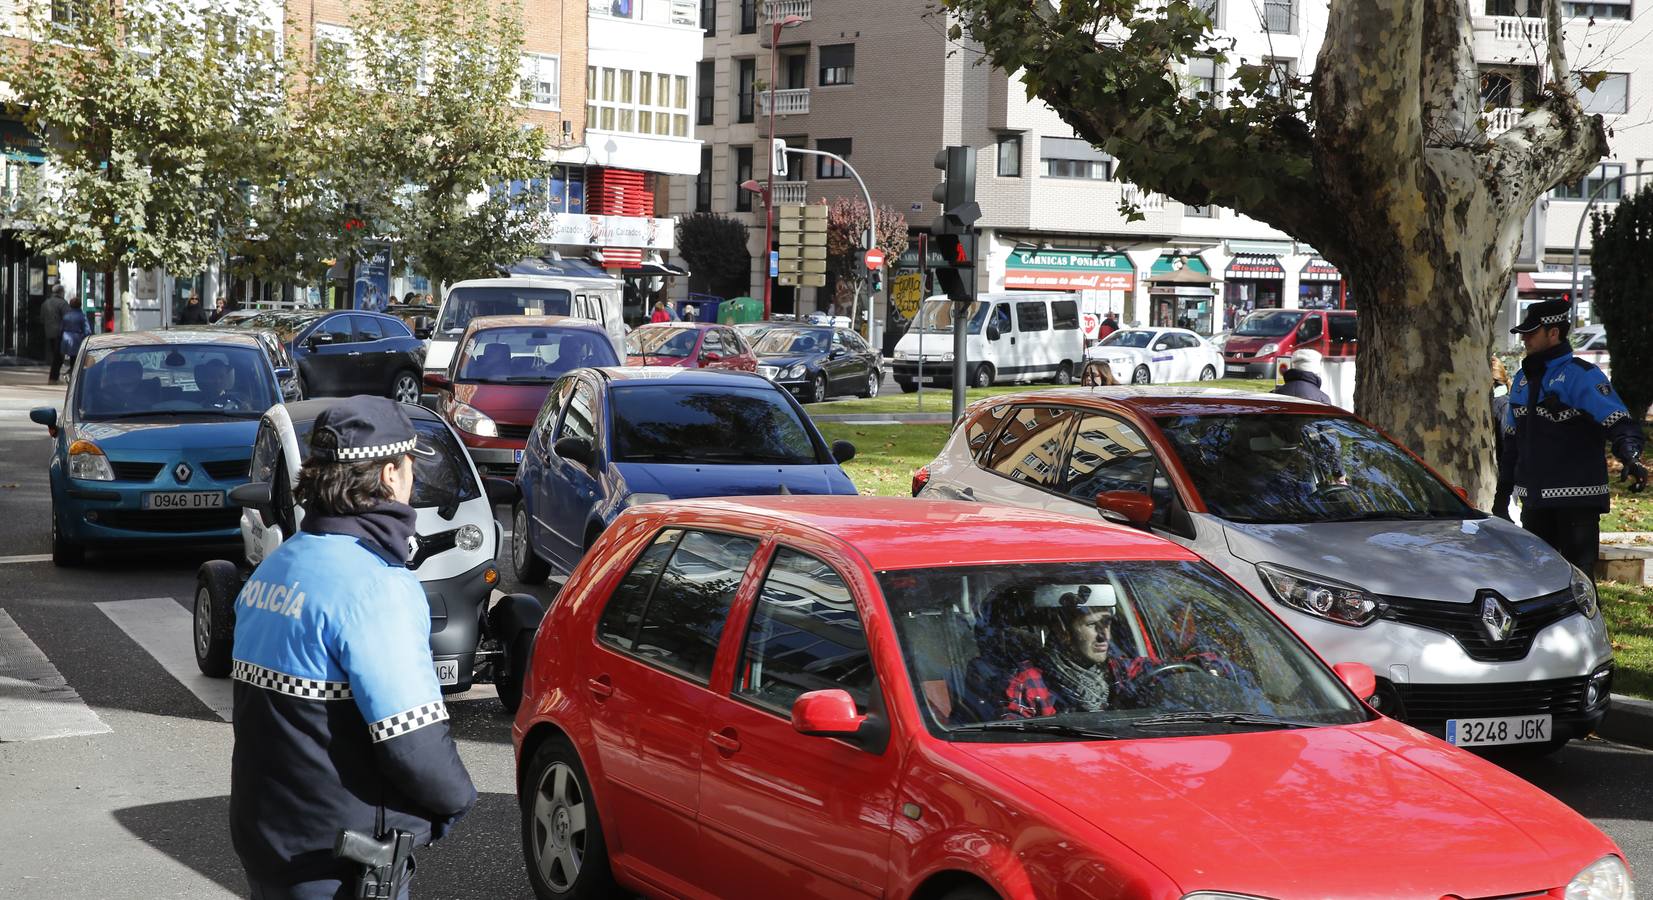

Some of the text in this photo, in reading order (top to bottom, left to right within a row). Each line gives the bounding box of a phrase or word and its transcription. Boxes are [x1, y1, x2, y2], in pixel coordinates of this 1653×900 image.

[616, 227, 641, 237] Calzados
[1021, 253, 1117, 267] CARNICAS PONIENTE
[154, 493, 220, 508] 0946 DTZ
[240, 580, 306, 619] POLICÍA
[1462, 721, 1508, 742] 3248
[1514, 719, 1546, 740] JGK
